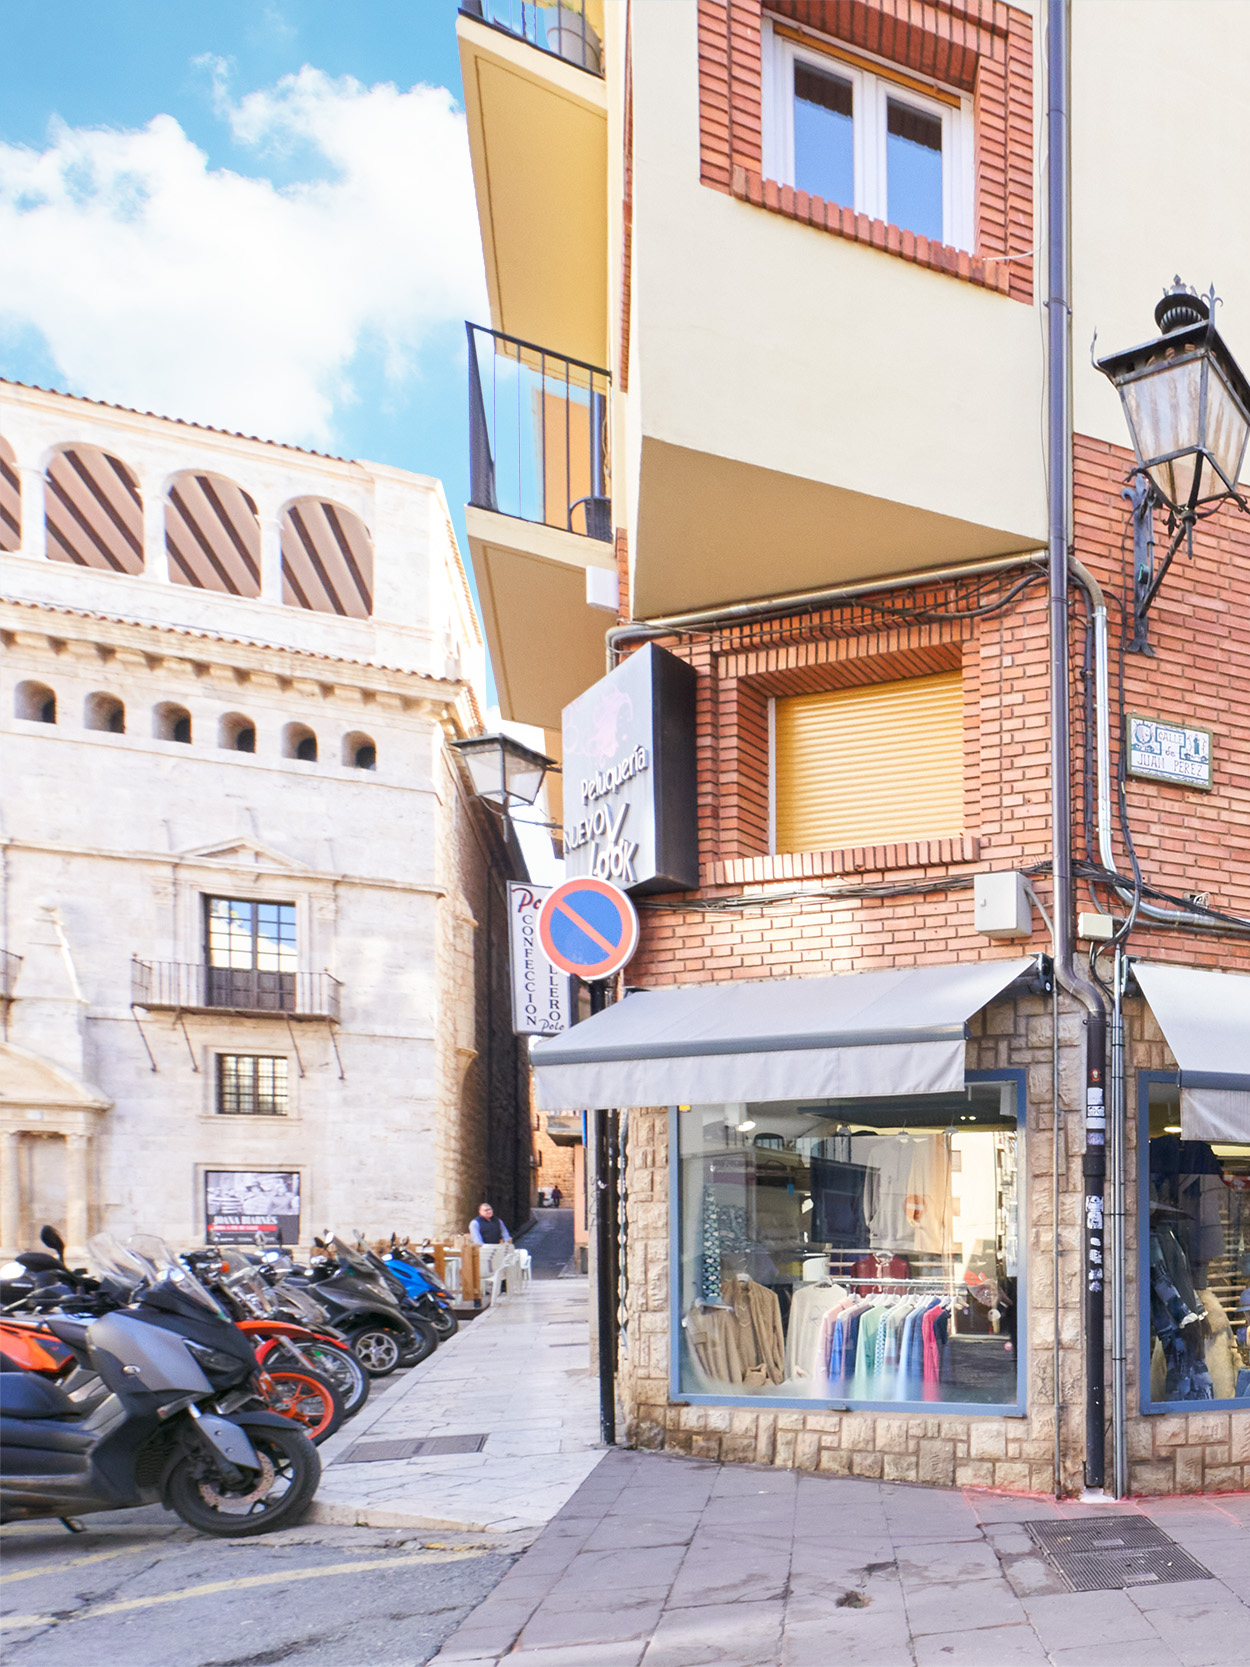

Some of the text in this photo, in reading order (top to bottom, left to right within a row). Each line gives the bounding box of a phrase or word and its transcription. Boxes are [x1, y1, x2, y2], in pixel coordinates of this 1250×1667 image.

[1158, 731, 1184, 745] CALLE
[1165, 746, 1176, 758] de
[1137, 753, 1203, 777] JUAN PEREZ
[581, 745, 649, 806] Peluquería
[563, 808, 606, 854] NUEVO
[522, 914, 537, 1026] CONFECCION
[539, 1018, 565, 1032] Polo
[213, 1215, 240, 1225] JOANA
